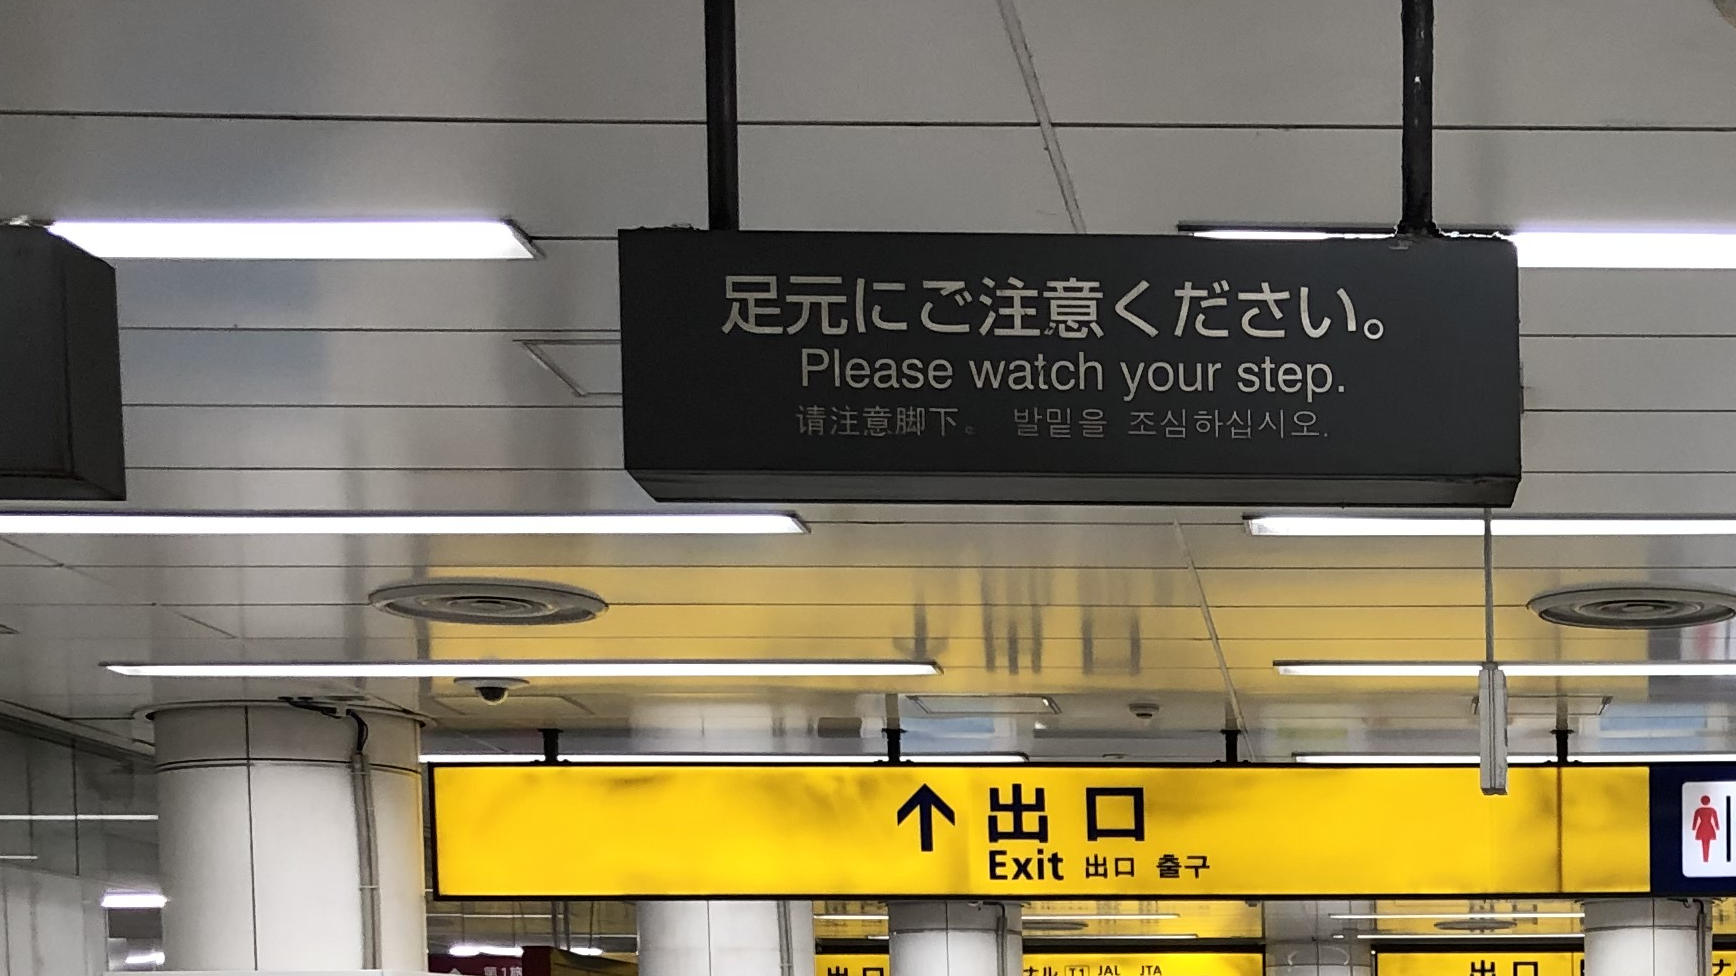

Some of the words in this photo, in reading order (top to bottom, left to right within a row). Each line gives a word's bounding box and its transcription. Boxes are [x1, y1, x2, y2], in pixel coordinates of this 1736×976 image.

[721, 275, 1386, 341] 足元にご注意ください。
[800, 347, 953, 392] Please
[968, 347, 1104, 393] watch
[1120, 358, 1222, 402] your
[1236, 355, 1346, 403] step.
[796, 404, 976, 438] 请注意脚下。
[1013, 405, 1108, 439] 발밑을
[1126, 405, 1329, 440] 조심하십시오.
[988, 783, 1146, 843] 出口
[989, 848, 1064, 881] Exit
[1084, 855, 1136, 878] 出口
[1155, 853, 1211, 880] 출구
[1098, 965, 1121, 976] JAL
[1140, 965, 1162, 976] JTA
